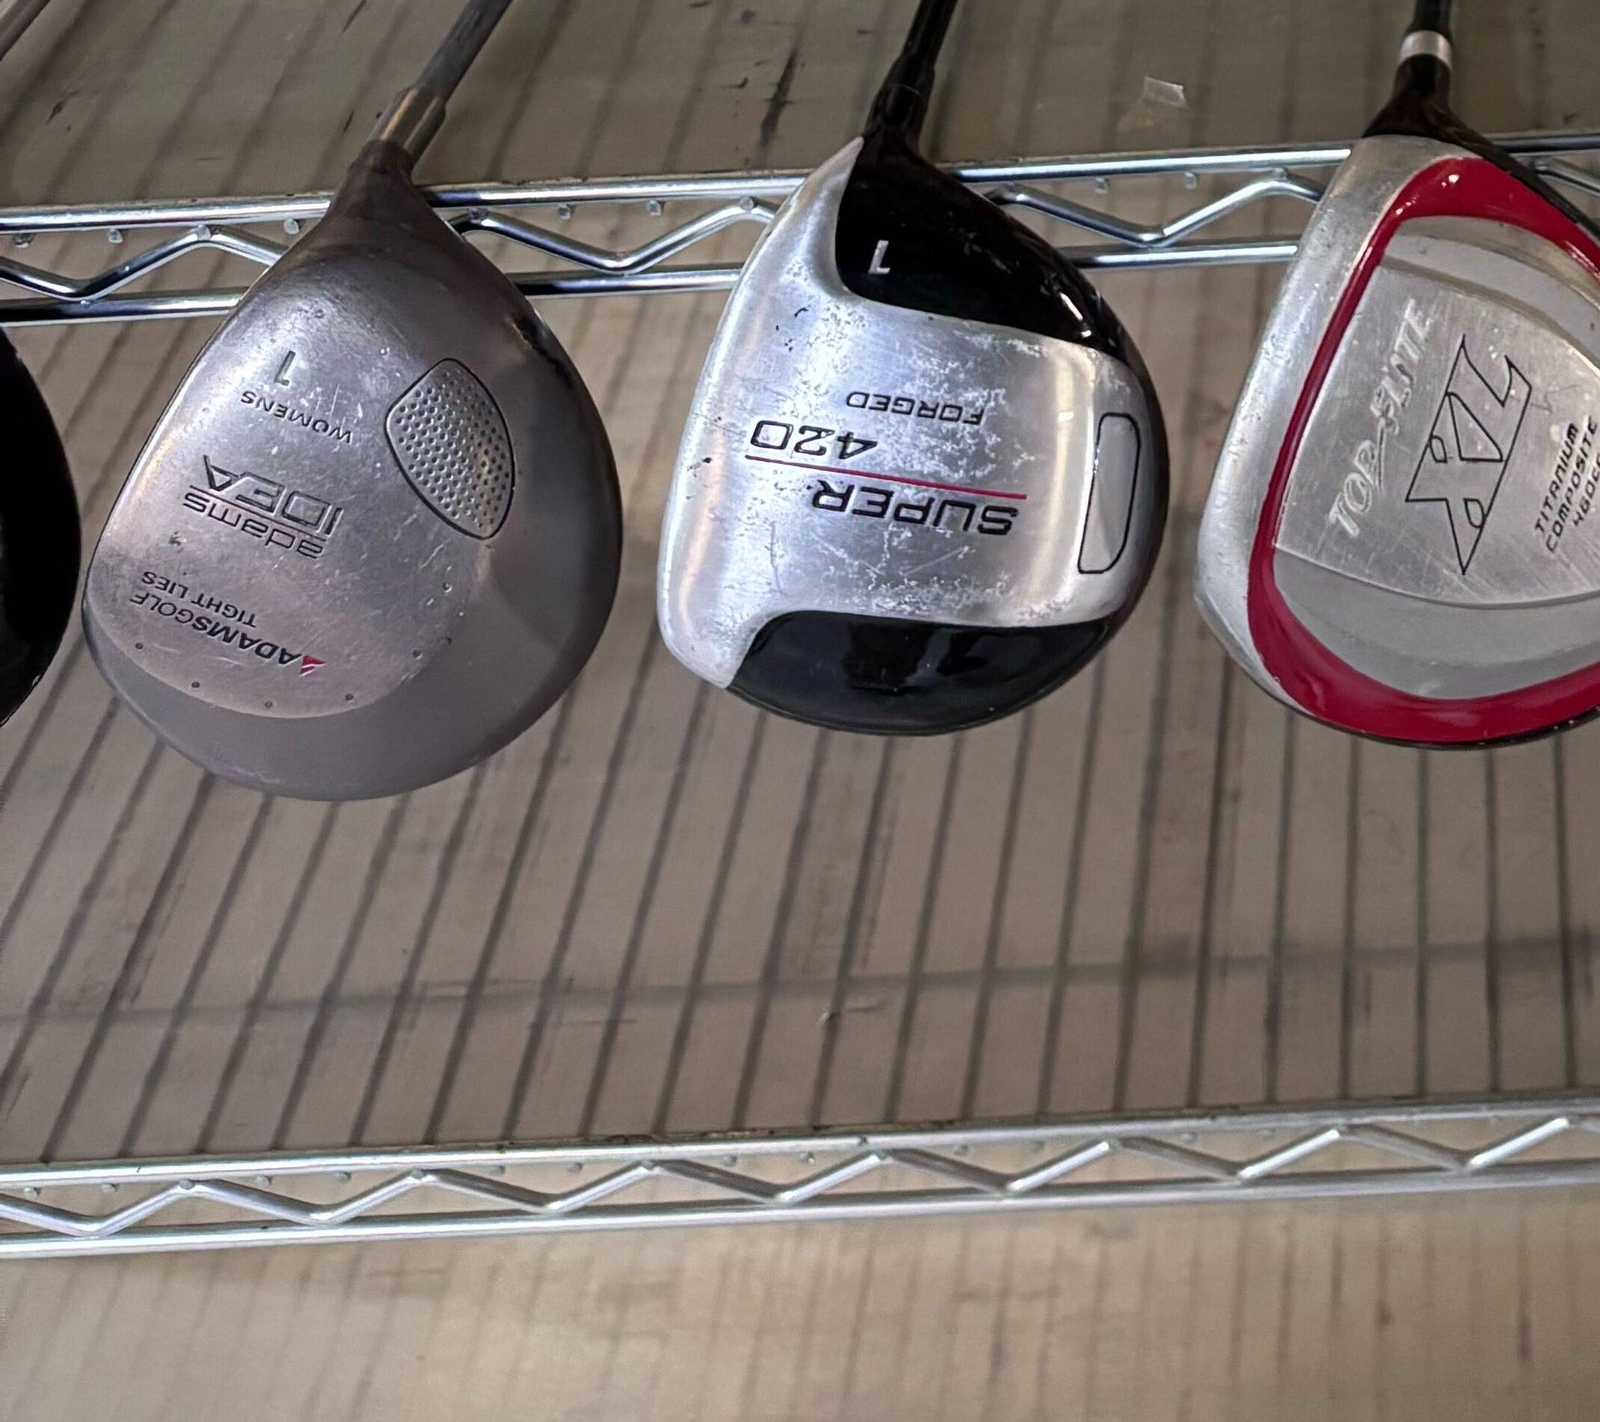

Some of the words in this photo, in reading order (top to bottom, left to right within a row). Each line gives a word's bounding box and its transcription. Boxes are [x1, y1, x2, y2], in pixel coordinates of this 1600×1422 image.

[868, 240, 892, 276] 1
[273, 351, 297, 387] 1
[239, 390, 353, 445] WOMENS
[846, 391, 985, 426] FORGED
[750, 420, 879, 461] 420
[202, 455, 343, 537] IDEA
[1534, 423, 1578, 533] TITANIUM
[1545, 414, 1598, 553] COMPOSITE
[183, 492, 328, 560] adams
[811, 480, 1020, 537] SUPER
[140, 571, 189, 600] LIES
[191, 590, 256, 629] TIGHT
